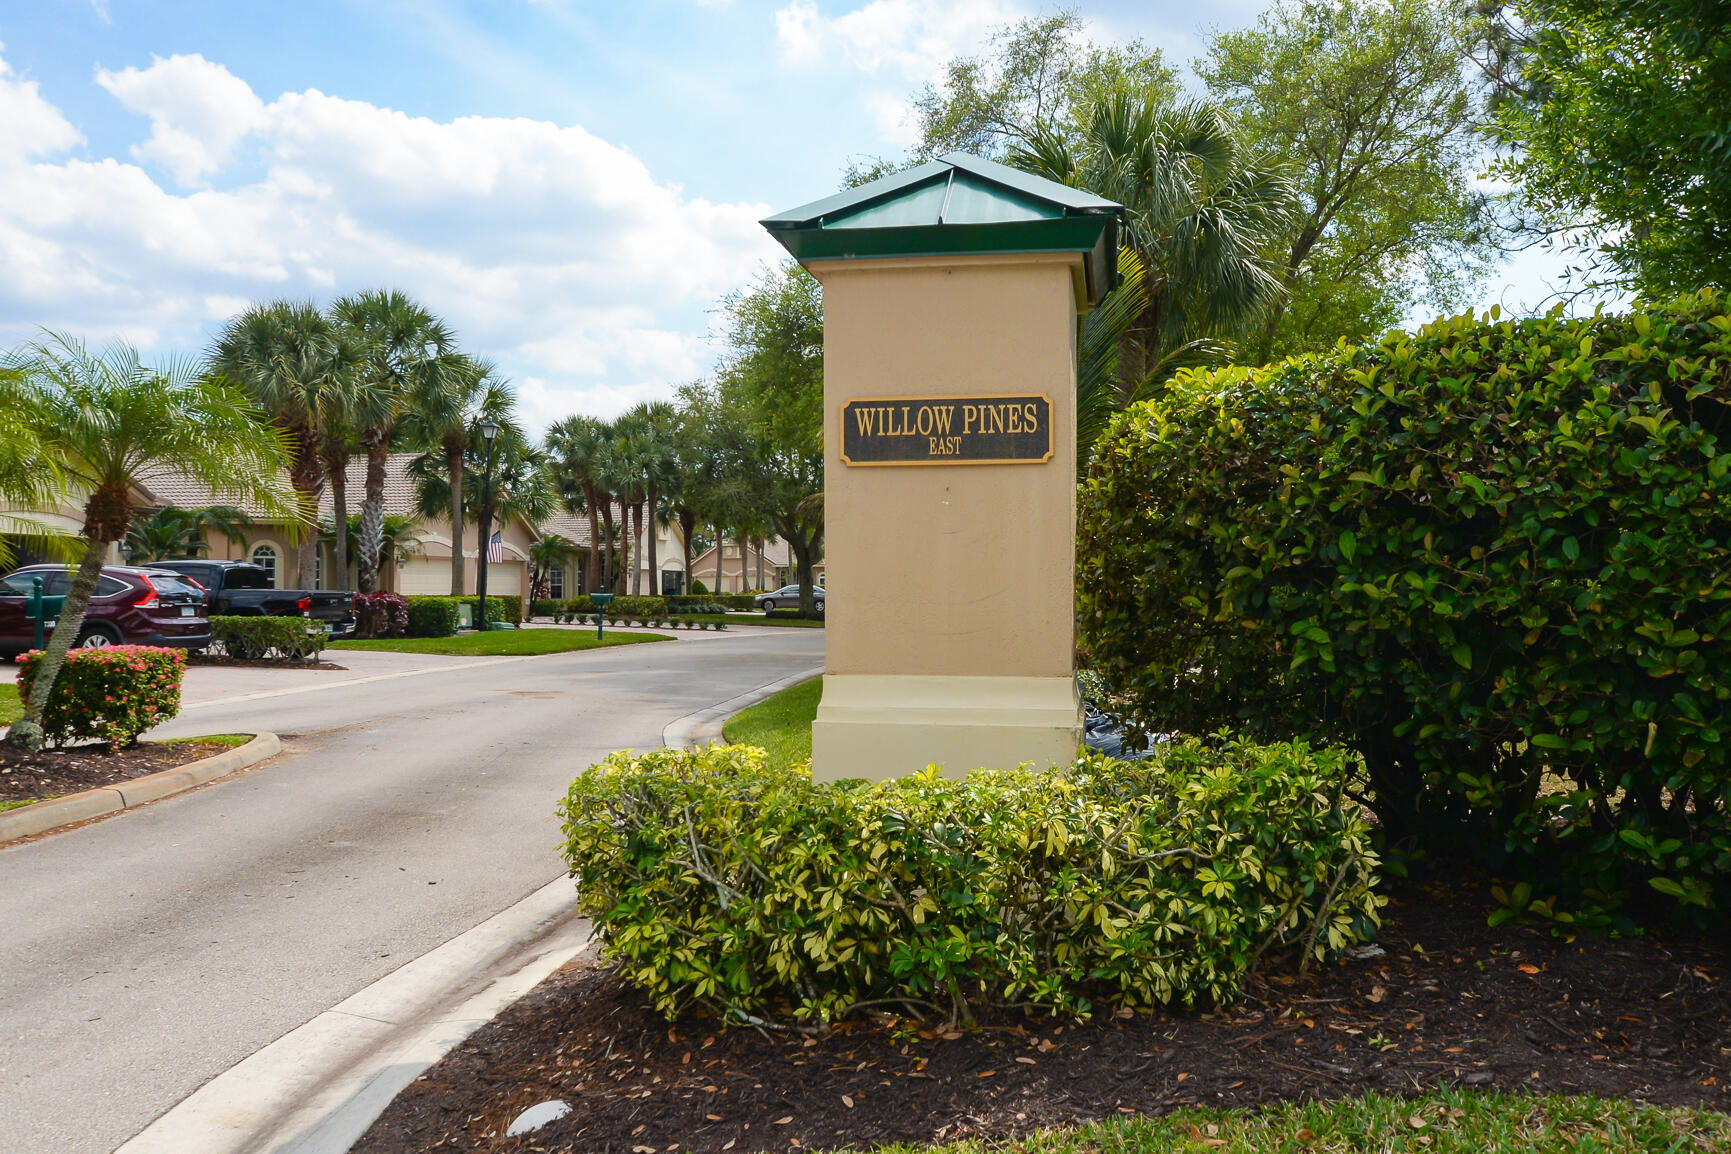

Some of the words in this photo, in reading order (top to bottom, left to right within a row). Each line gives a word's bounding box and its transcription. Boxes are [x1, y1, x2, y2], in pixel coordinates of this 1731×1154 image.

[855, 405, 955, 437] WILLOW
[962, 403, 1038, 434] PINES
[928, 436, 962, 455] EAST
